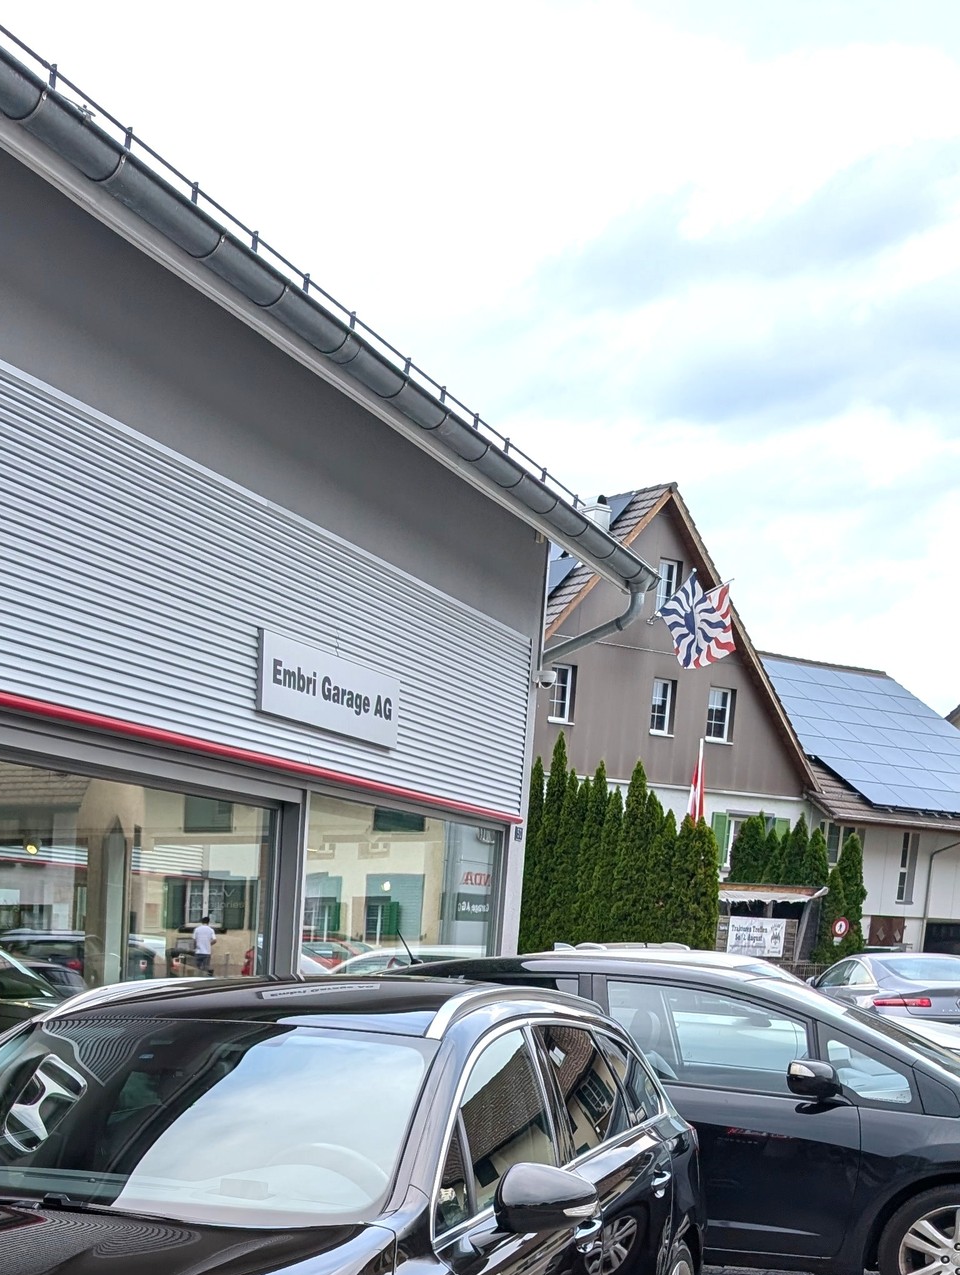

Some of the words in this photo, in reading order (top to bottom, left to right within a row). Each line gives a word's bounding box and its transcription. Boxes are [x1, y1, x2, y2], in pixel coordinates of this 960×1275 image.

[272, 658, 317, 697] Embri
[321, 676, 371, 716] Garage
[374, 695, 393, 721] AG
